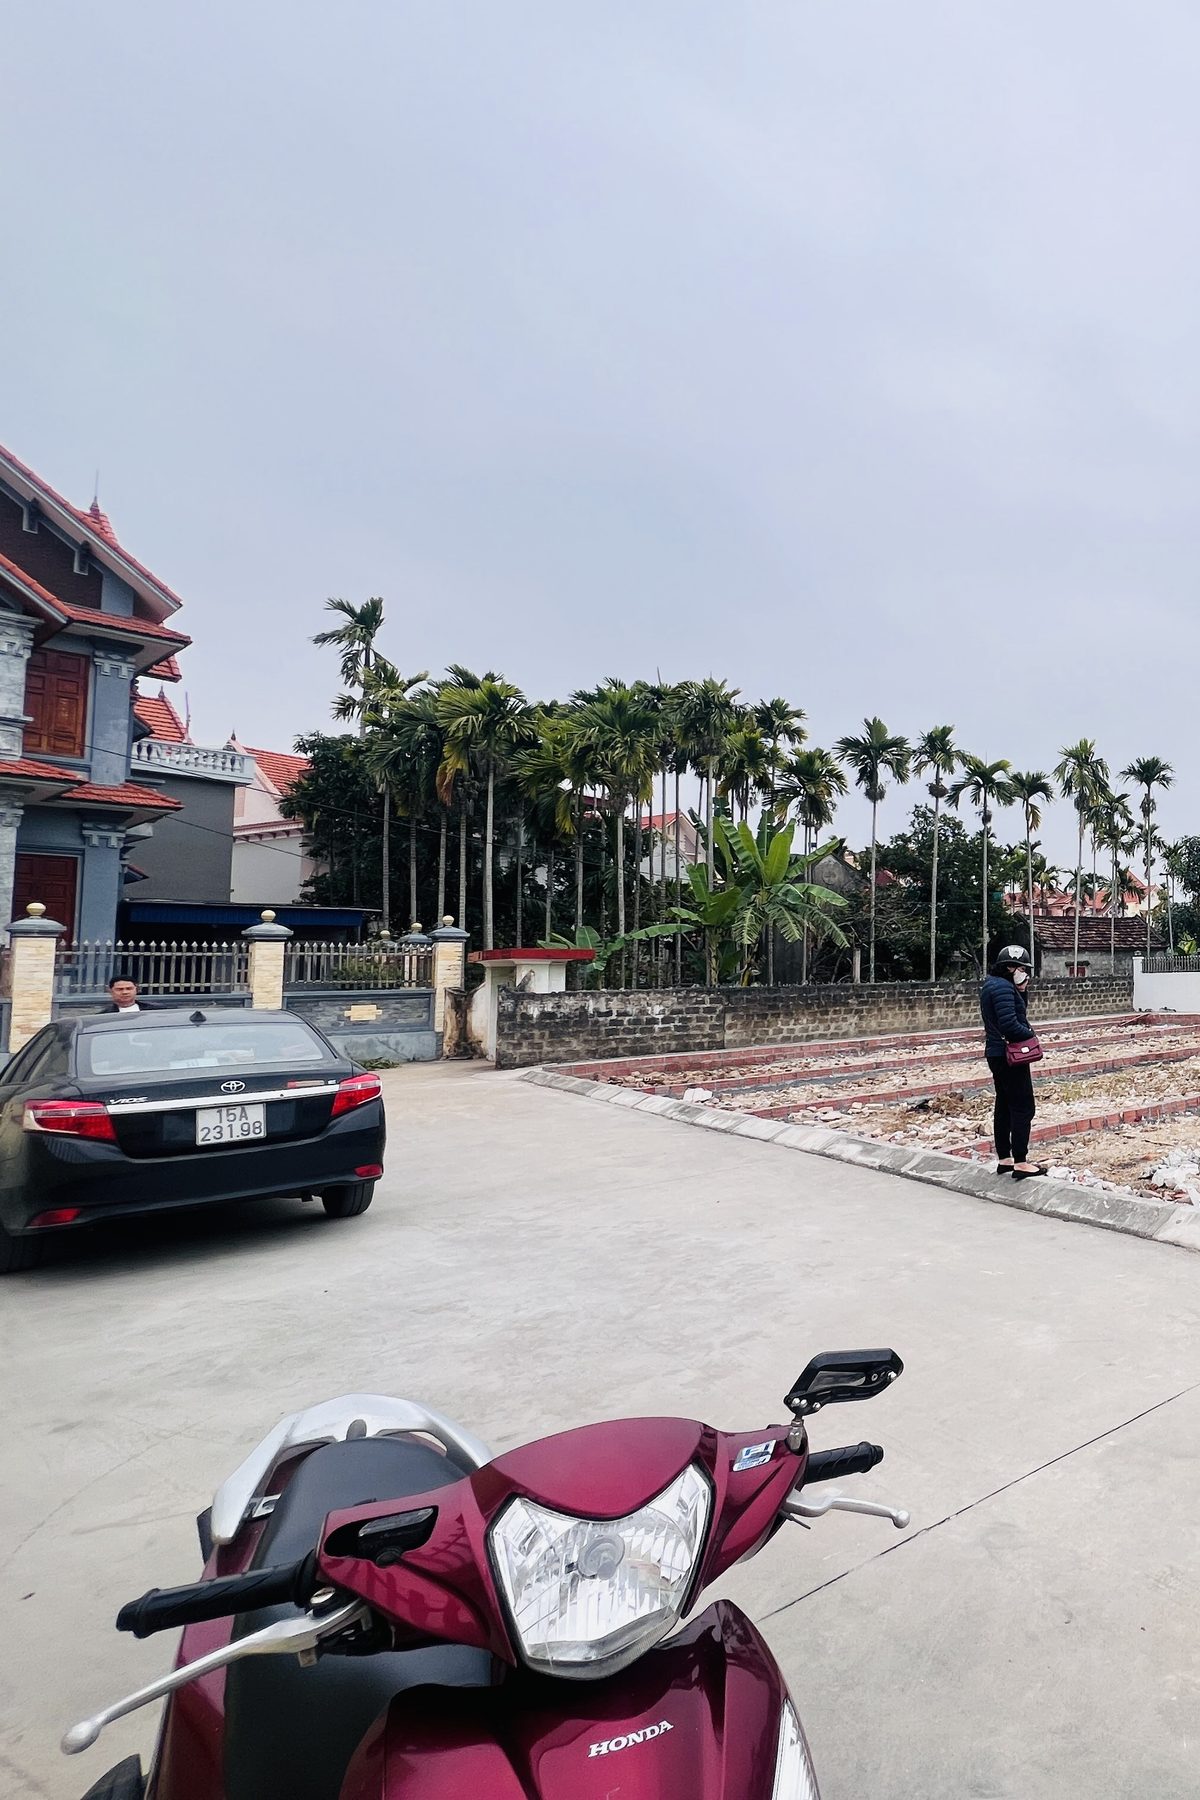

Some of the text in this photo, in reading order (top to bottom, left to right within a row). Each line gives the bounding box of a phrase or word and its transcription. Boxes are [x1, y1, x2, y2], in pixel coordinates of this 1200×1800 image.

[216, 1107, 248, 1123] 15A
[200, 1120, 263, 1142] 231.98
[587, 1720, 674, 1757] HONDA
